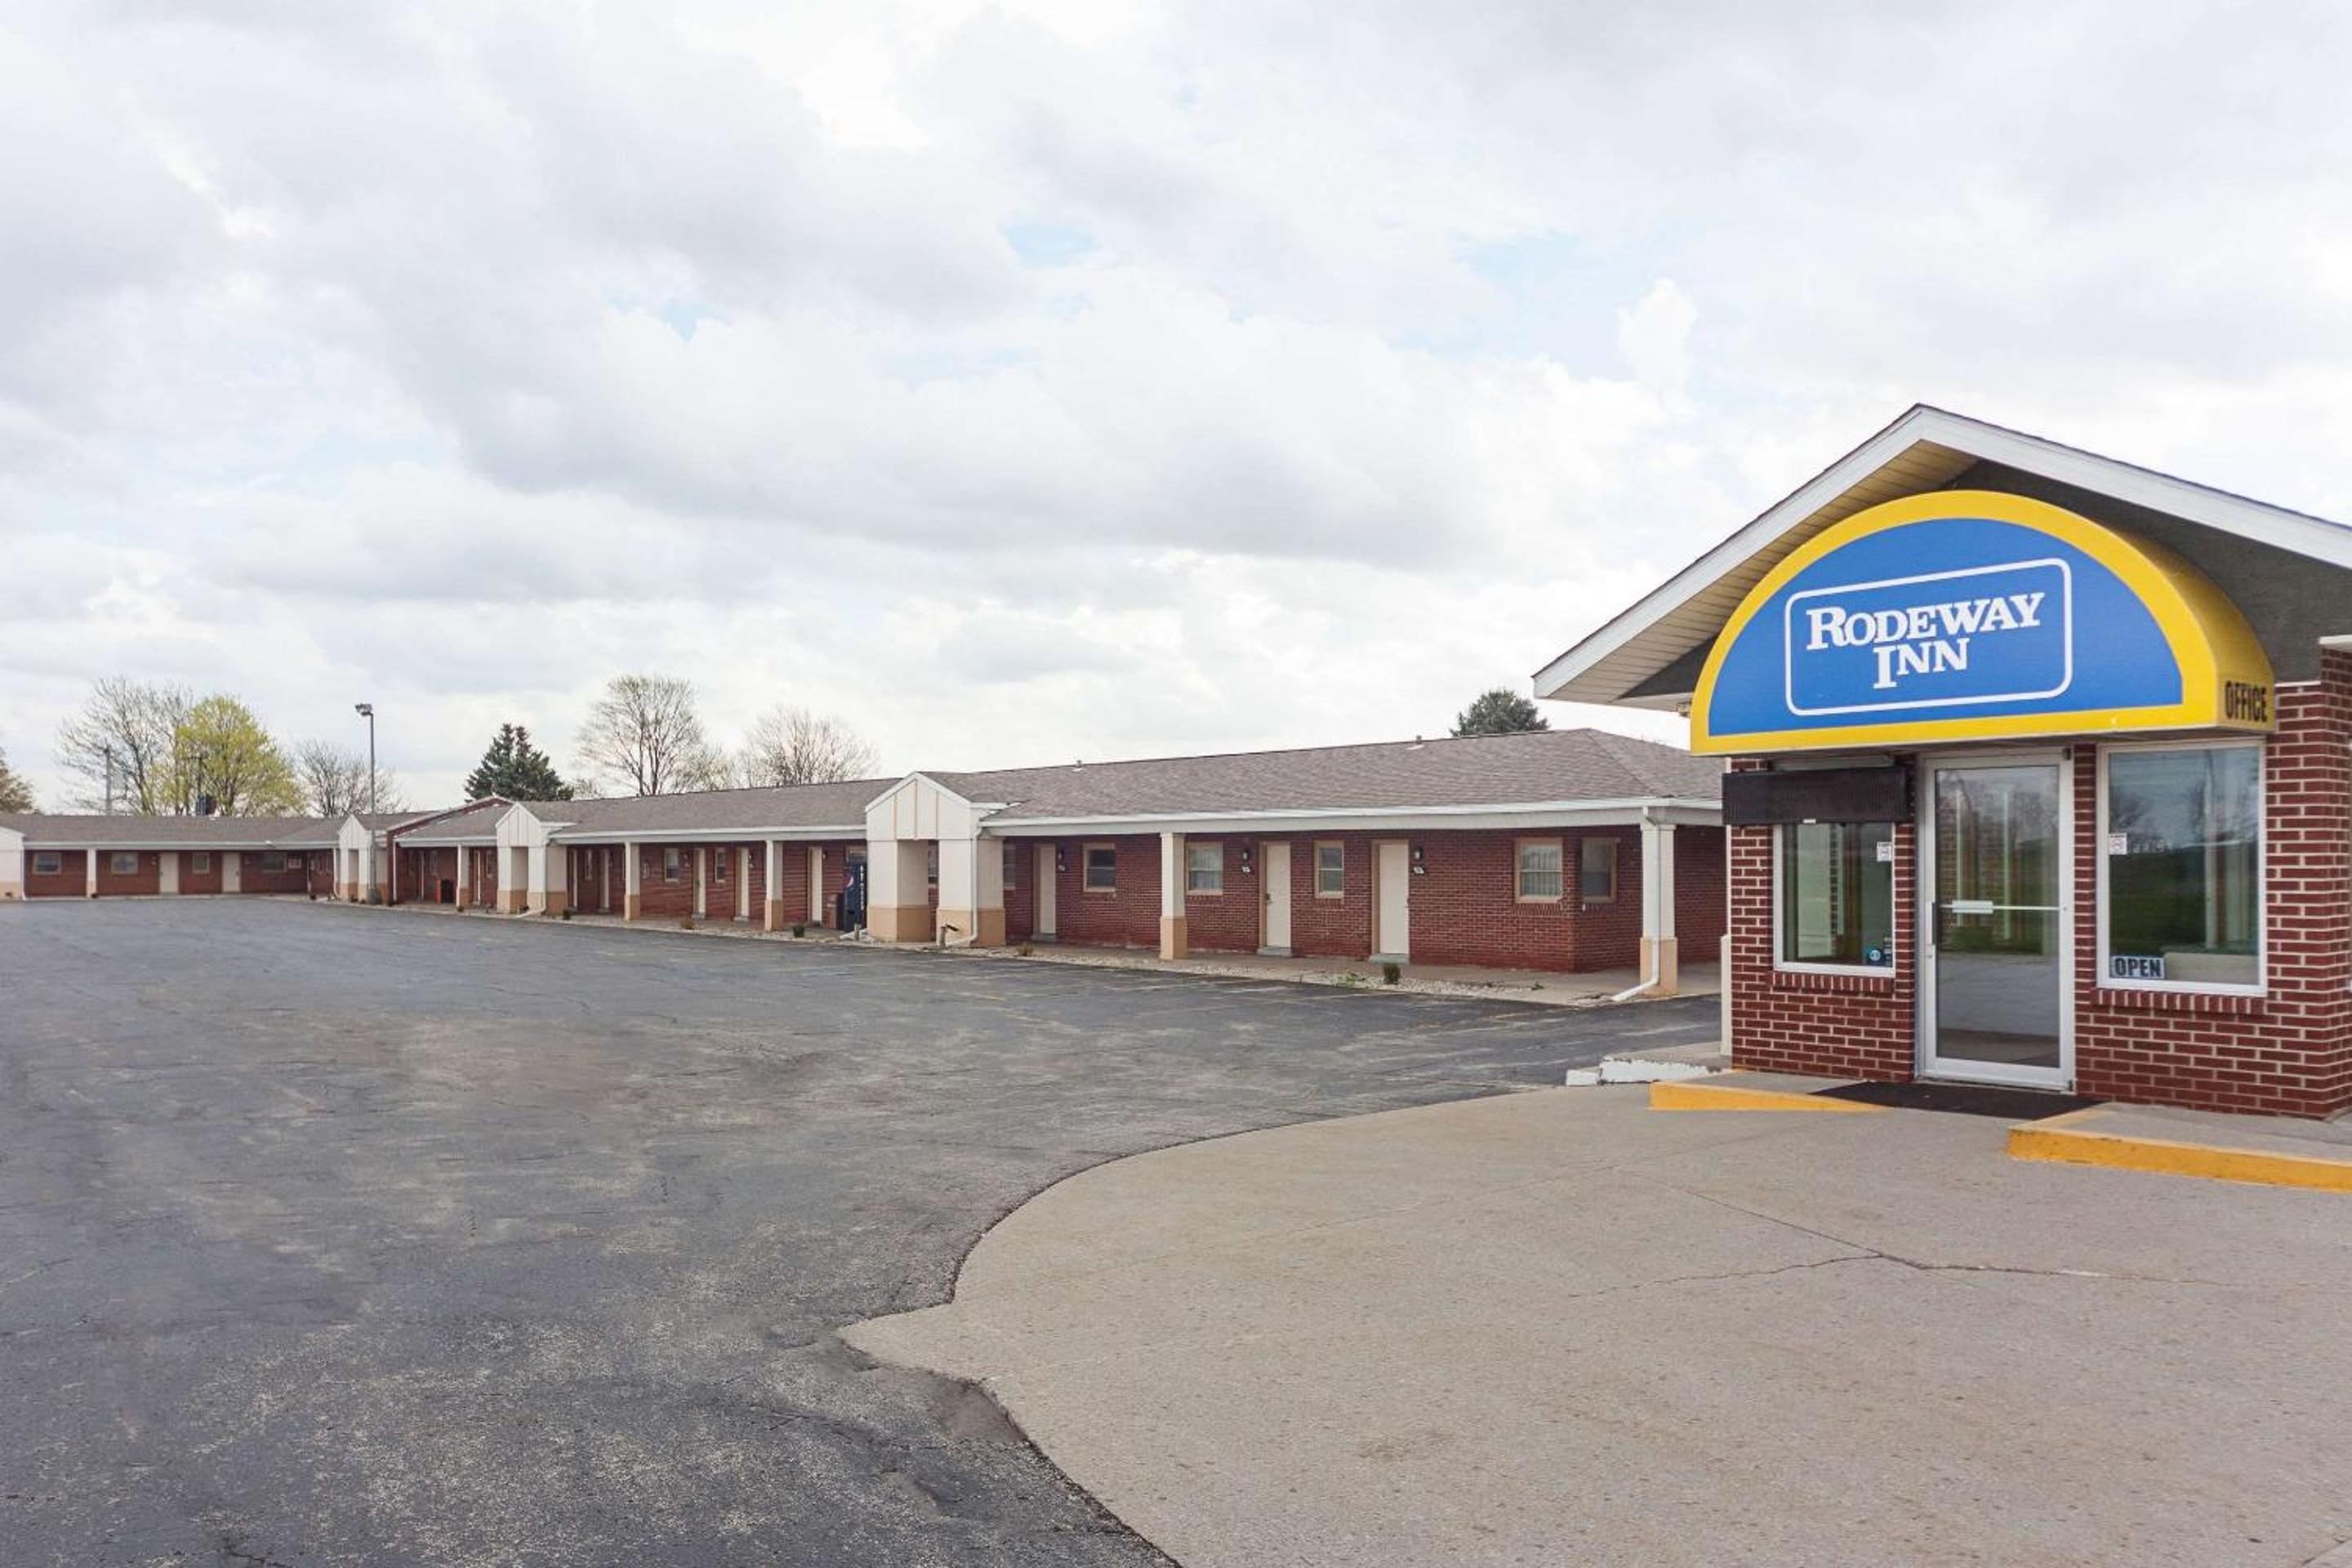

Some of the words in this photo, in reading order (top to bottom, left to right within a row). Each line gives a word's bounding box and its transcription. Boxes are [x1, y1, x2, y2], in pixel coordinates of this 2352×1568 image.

[1806, 592, 2045, 650] RODEWAY
[1873, 638, 1970, 688] INN
[2225, 680, 2267, 723] OFFICE
[2115, 957, 2161, 977] OPEN
